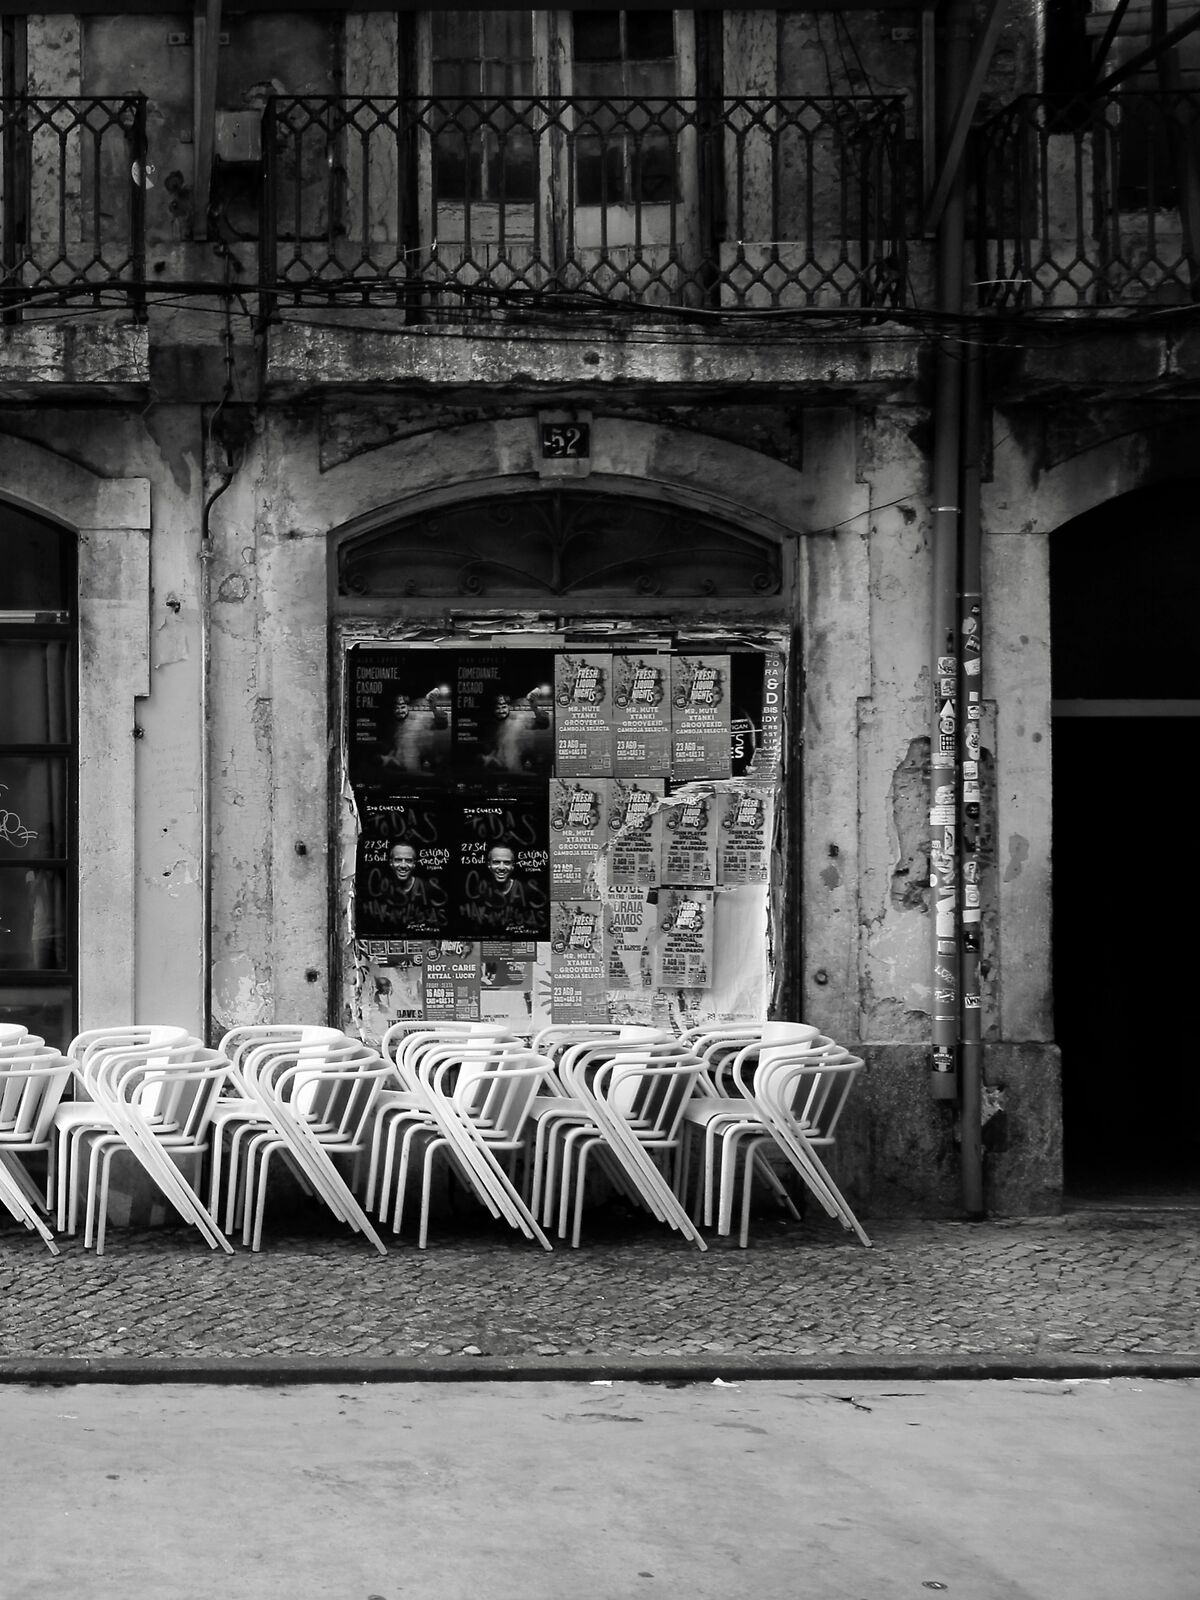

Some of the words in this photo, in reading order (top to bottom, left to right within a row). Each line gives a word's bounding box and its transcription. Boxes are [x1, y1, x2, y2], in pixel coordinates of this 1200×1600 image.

[552, 428, 580, 455] 52
[577, 669, 599, 679] FRESH
[635, 670, 657, 679] FRESH
[695, 671, 716, 680] FRESH
[356, 681, 383, 694] CASADO
[457, 681, 484, 694] CASADO
[576, 679, 597, 688] LIQUID
[633, 680, 655, 689] LIQUID
[692, 680, 714, 690] LIQUID
[766, 678, 779, 690] &
[356, 696, 360, 708] E
[457, 696, 462, 709] E
[766, 692, 778, 704] D
[559, 740, 567, 748] 23
[617, 741, 625, 749] 23
[676, 742, 684, 751] 23
[572, 793, 593, 803] FRESH
[630, 793, 651, 803] FRESH
[570, 802, 591, 812] LIQUID
[364, 840, 375, 849] 27
[461, 843, 473, 852] 27
[553, 864, 561, 872] 23
[573, 916, 594, 926] FRESH
[571, 926, 592, 935] LIQUID
[427, 964, 447, 972] RIOT
[452, 964, 476, 972] CARIE
[433, 988, 445, 998] AGO
[554, 987, 562, 996] 23
